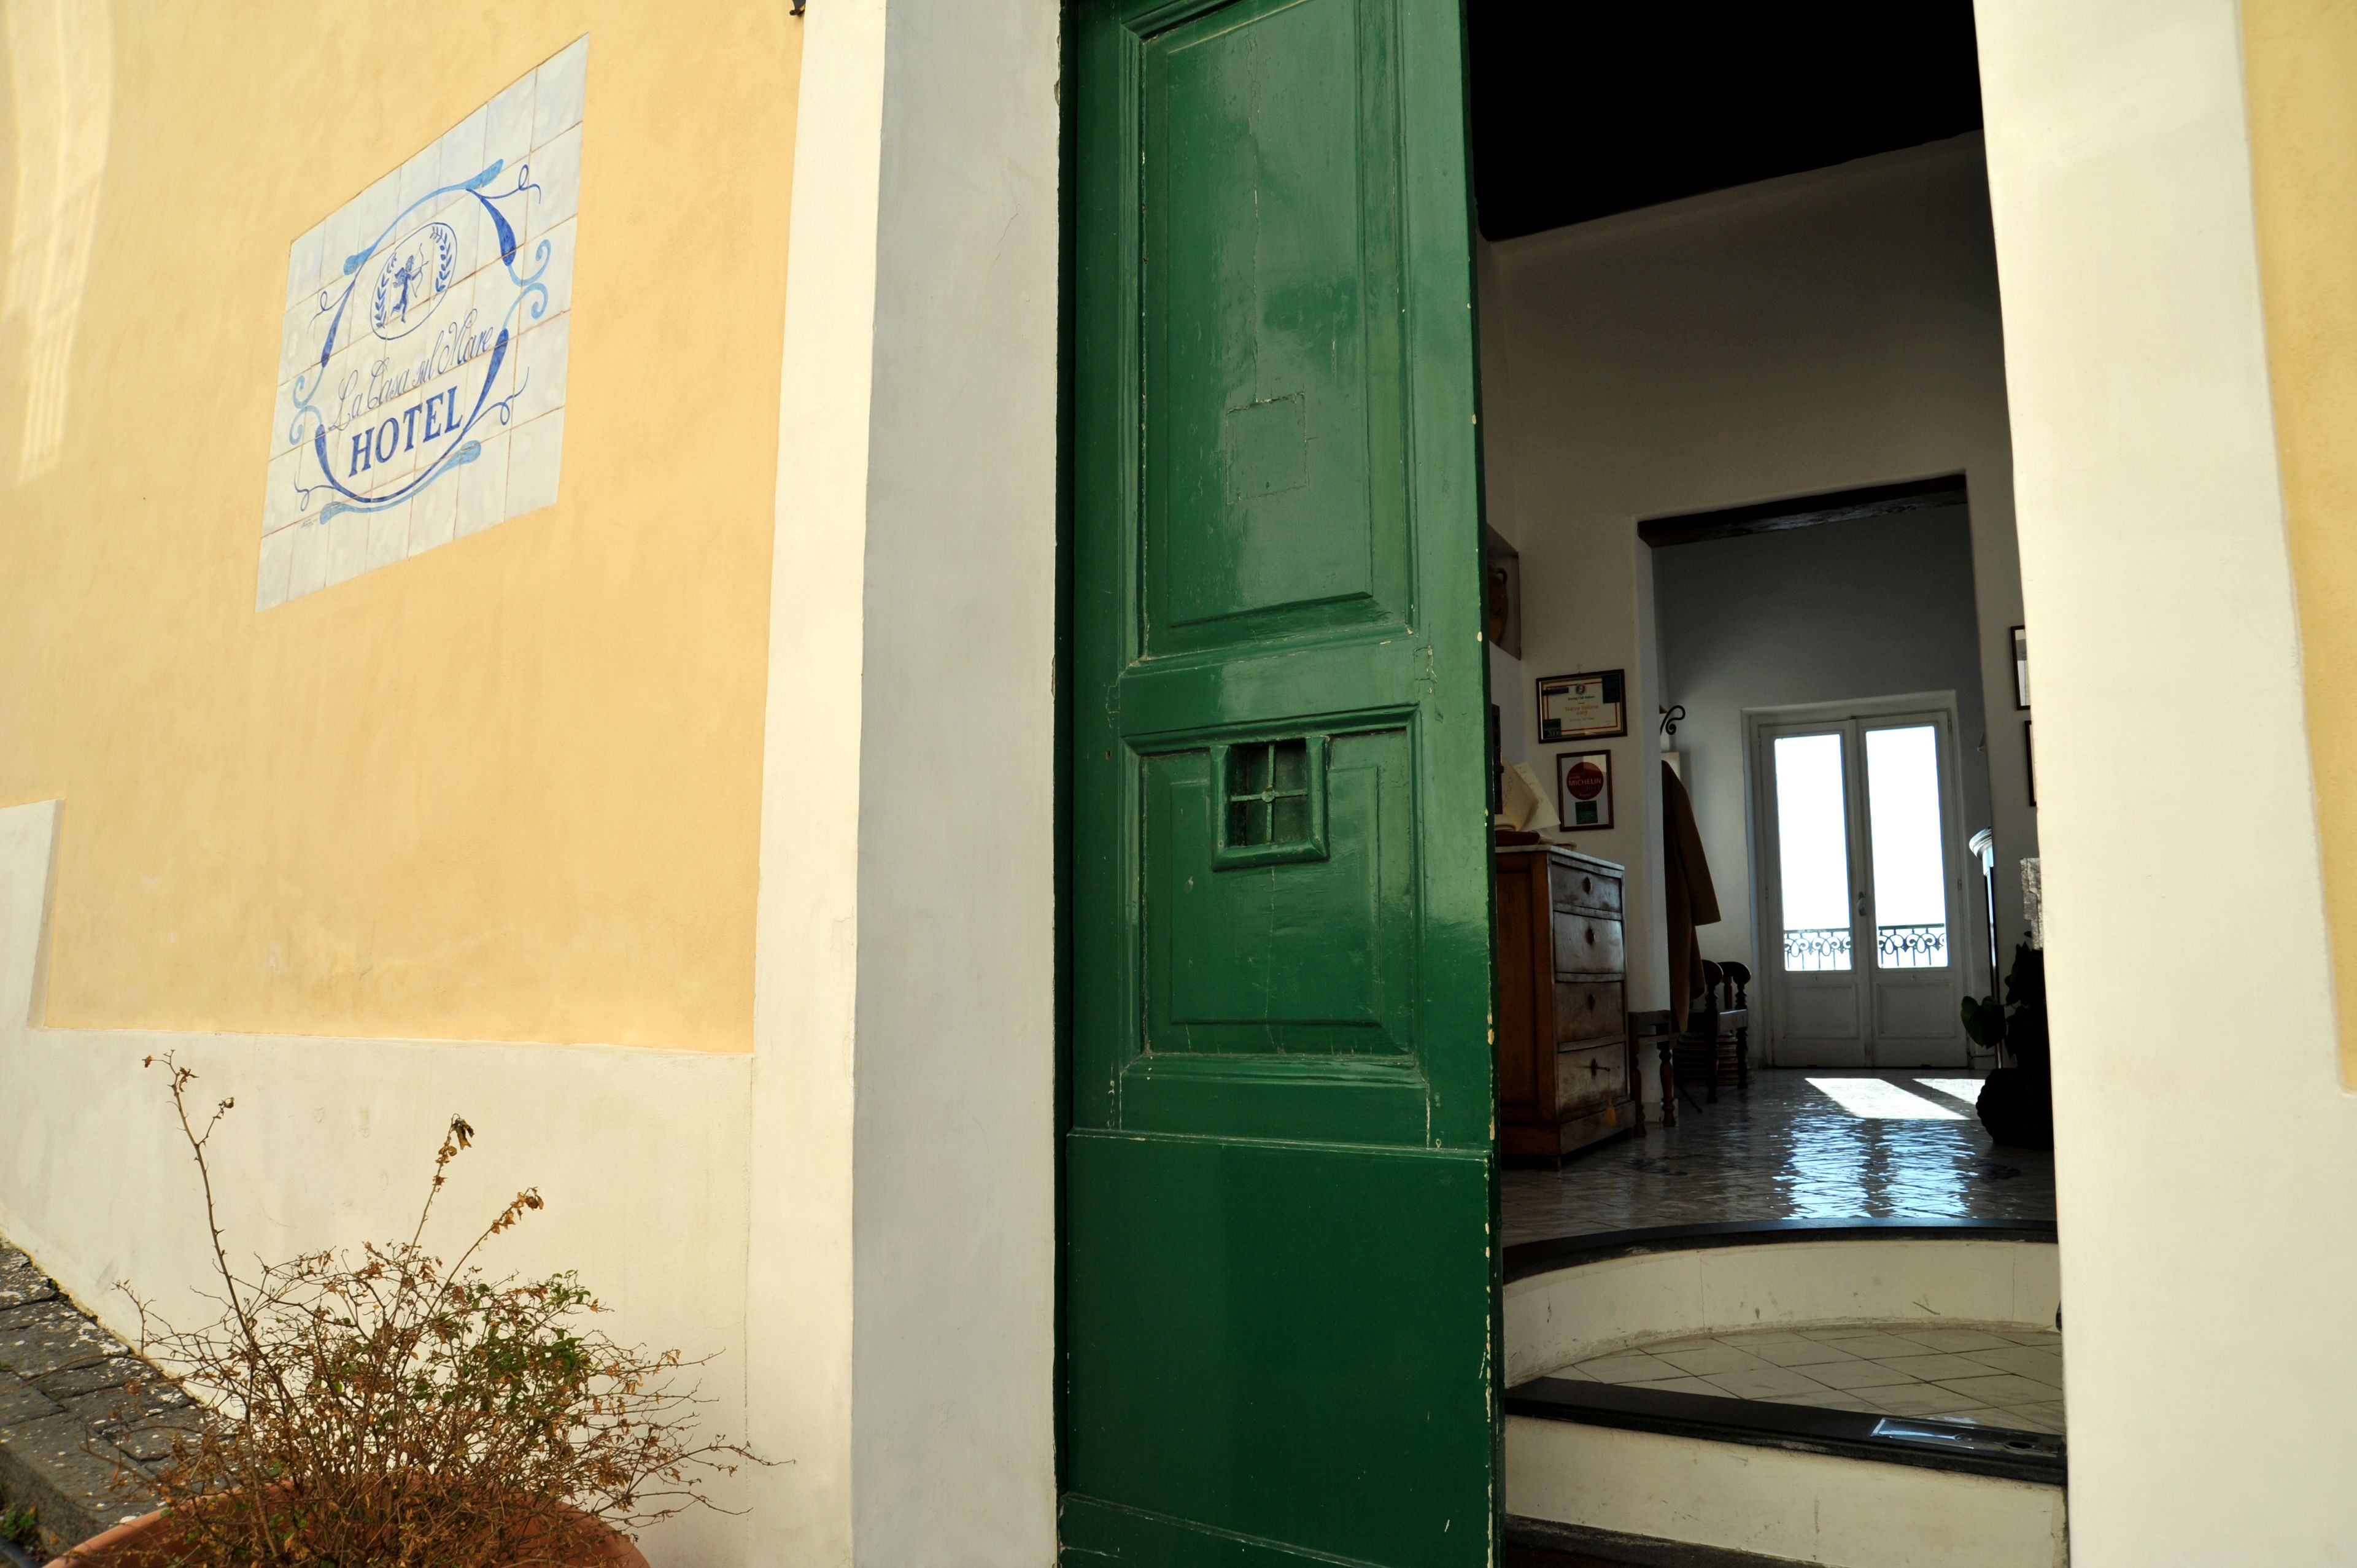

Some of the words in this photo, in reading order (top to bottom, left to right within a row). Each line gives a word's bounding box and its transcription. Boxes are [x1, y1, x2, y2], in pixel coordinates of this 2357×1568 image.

[328, 369, 363, 431] La
[367, 357, 409, 410] Casa
[412, 330, 444, 387] sul
[438, 308, 493, 376] Mare
[348, 385, 463, 478] HOTEL
[1568, 778, 1601, 786] MICHELIN
